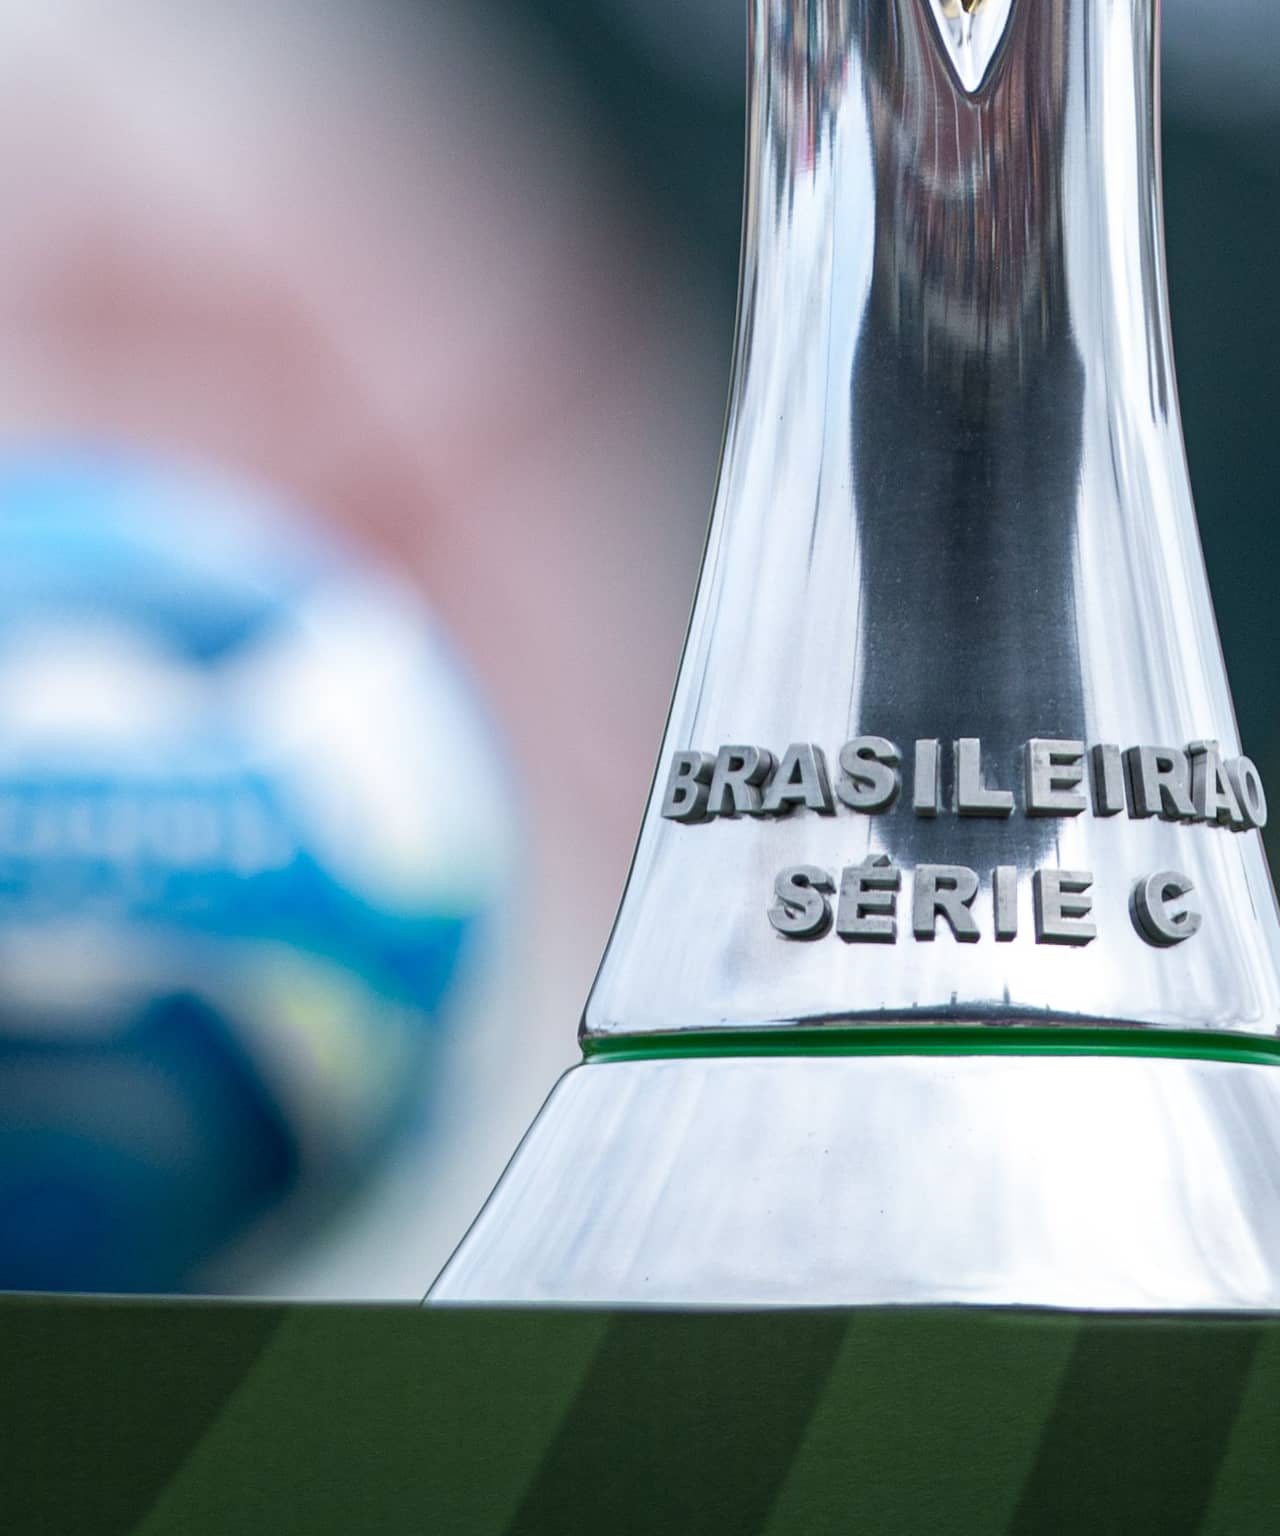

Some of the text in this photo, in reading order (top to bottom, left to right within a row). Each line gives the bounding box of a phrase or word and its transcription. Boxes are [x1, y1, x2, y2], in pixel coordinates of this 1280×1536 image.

[662, 736, 1267, 830] BRASILEIRÃO
[768, 856, 1203, 948] SÉRIE C
